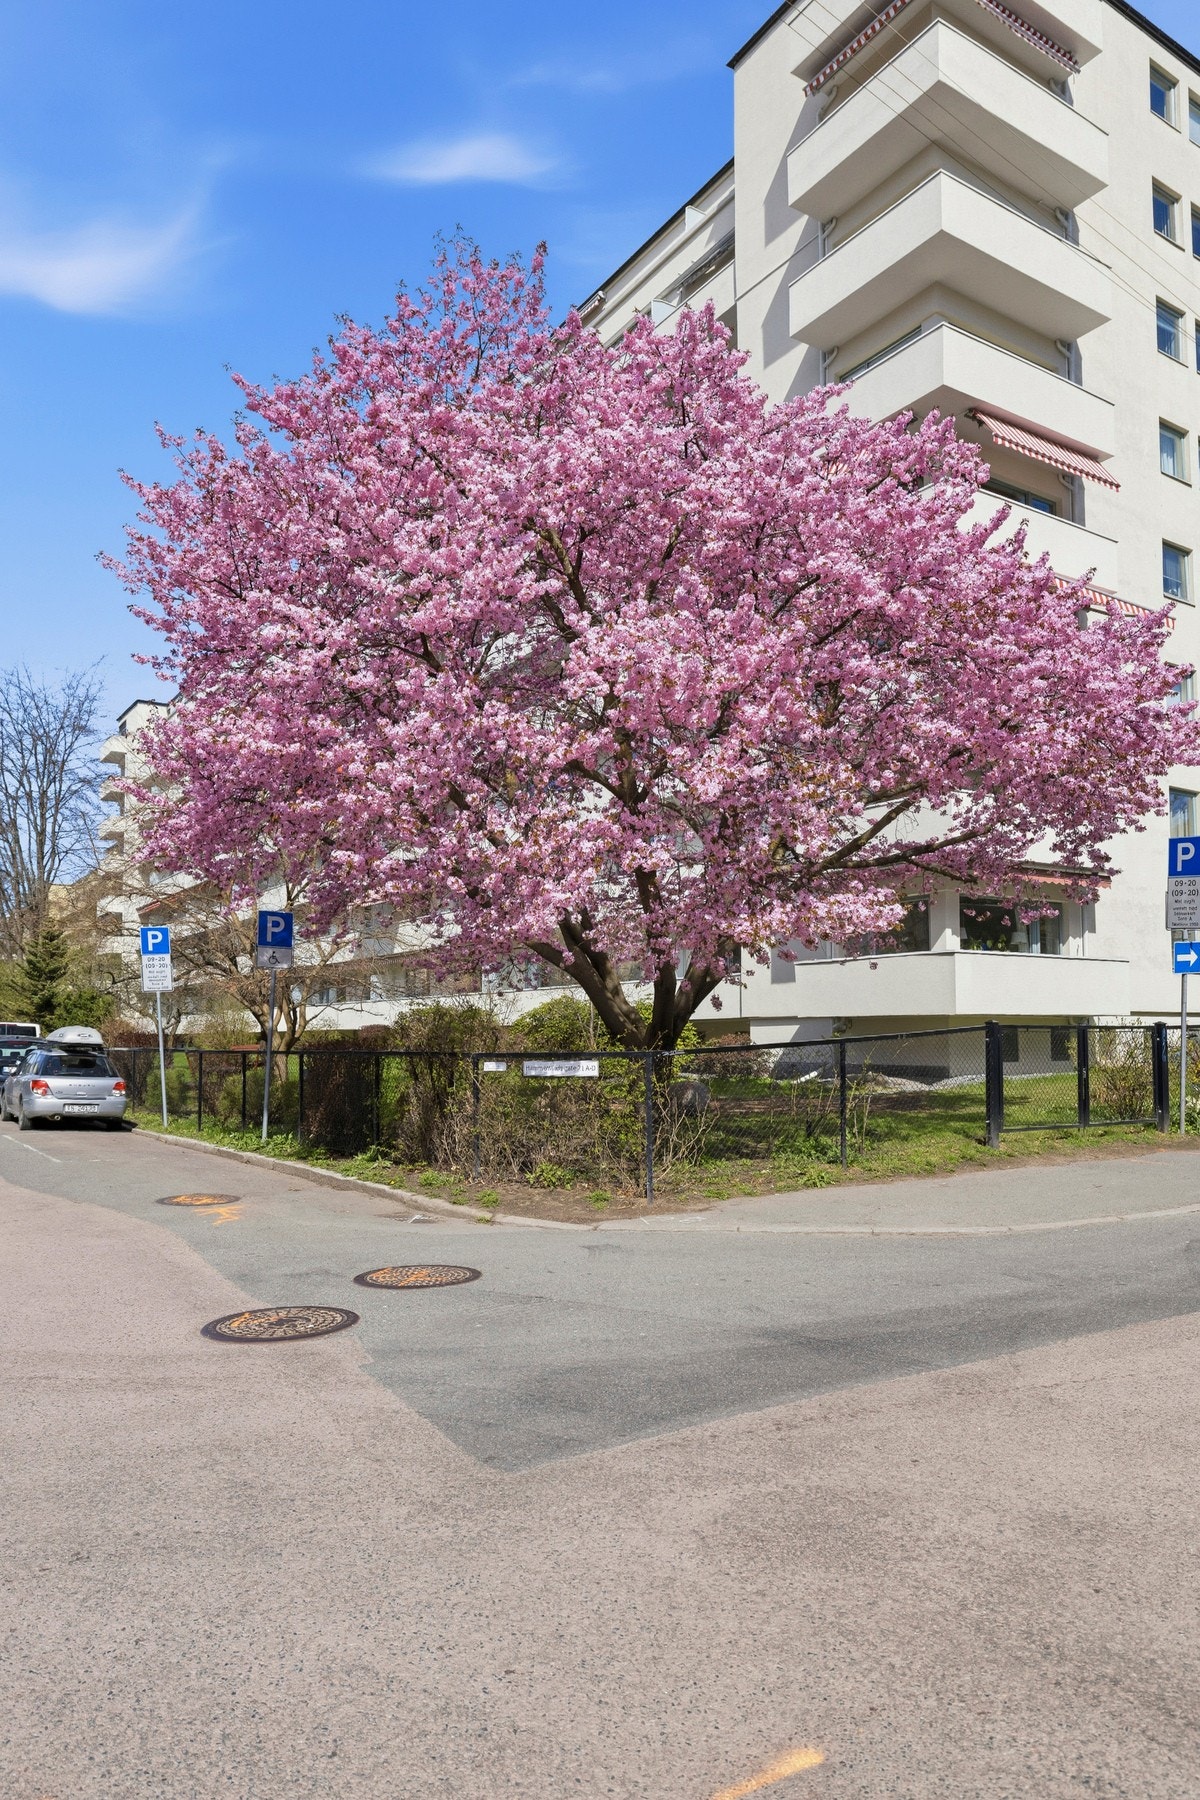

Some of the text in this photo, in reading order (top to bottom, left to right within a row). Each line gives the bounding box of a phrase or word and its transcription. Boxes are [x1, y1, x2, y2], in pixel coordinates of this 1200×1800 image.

[1177, 842, 1195, 872] P
[147, 930, 163, 952] P
[267, 915, 285, 942] P
